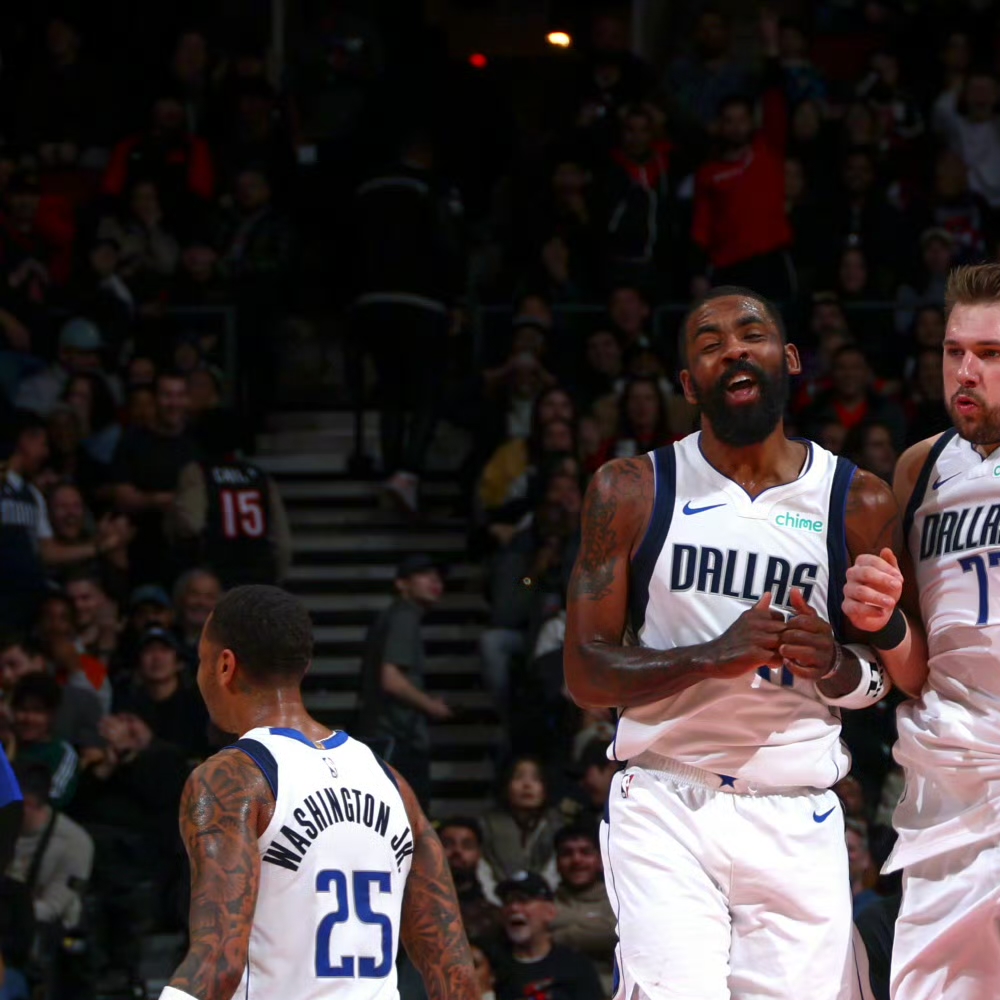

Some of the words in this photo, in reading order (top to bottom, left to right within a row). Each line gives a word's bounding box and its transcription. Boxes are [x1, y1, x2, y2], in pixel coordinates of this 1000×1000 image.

[218, 487, 268, 540] 15
[775, 512, 823, 532] chime
[670, 543, 819, 609] DALLAS
[262, 787, 391, 872] WASHINGTON
[315, 869, 392, 978] 25
